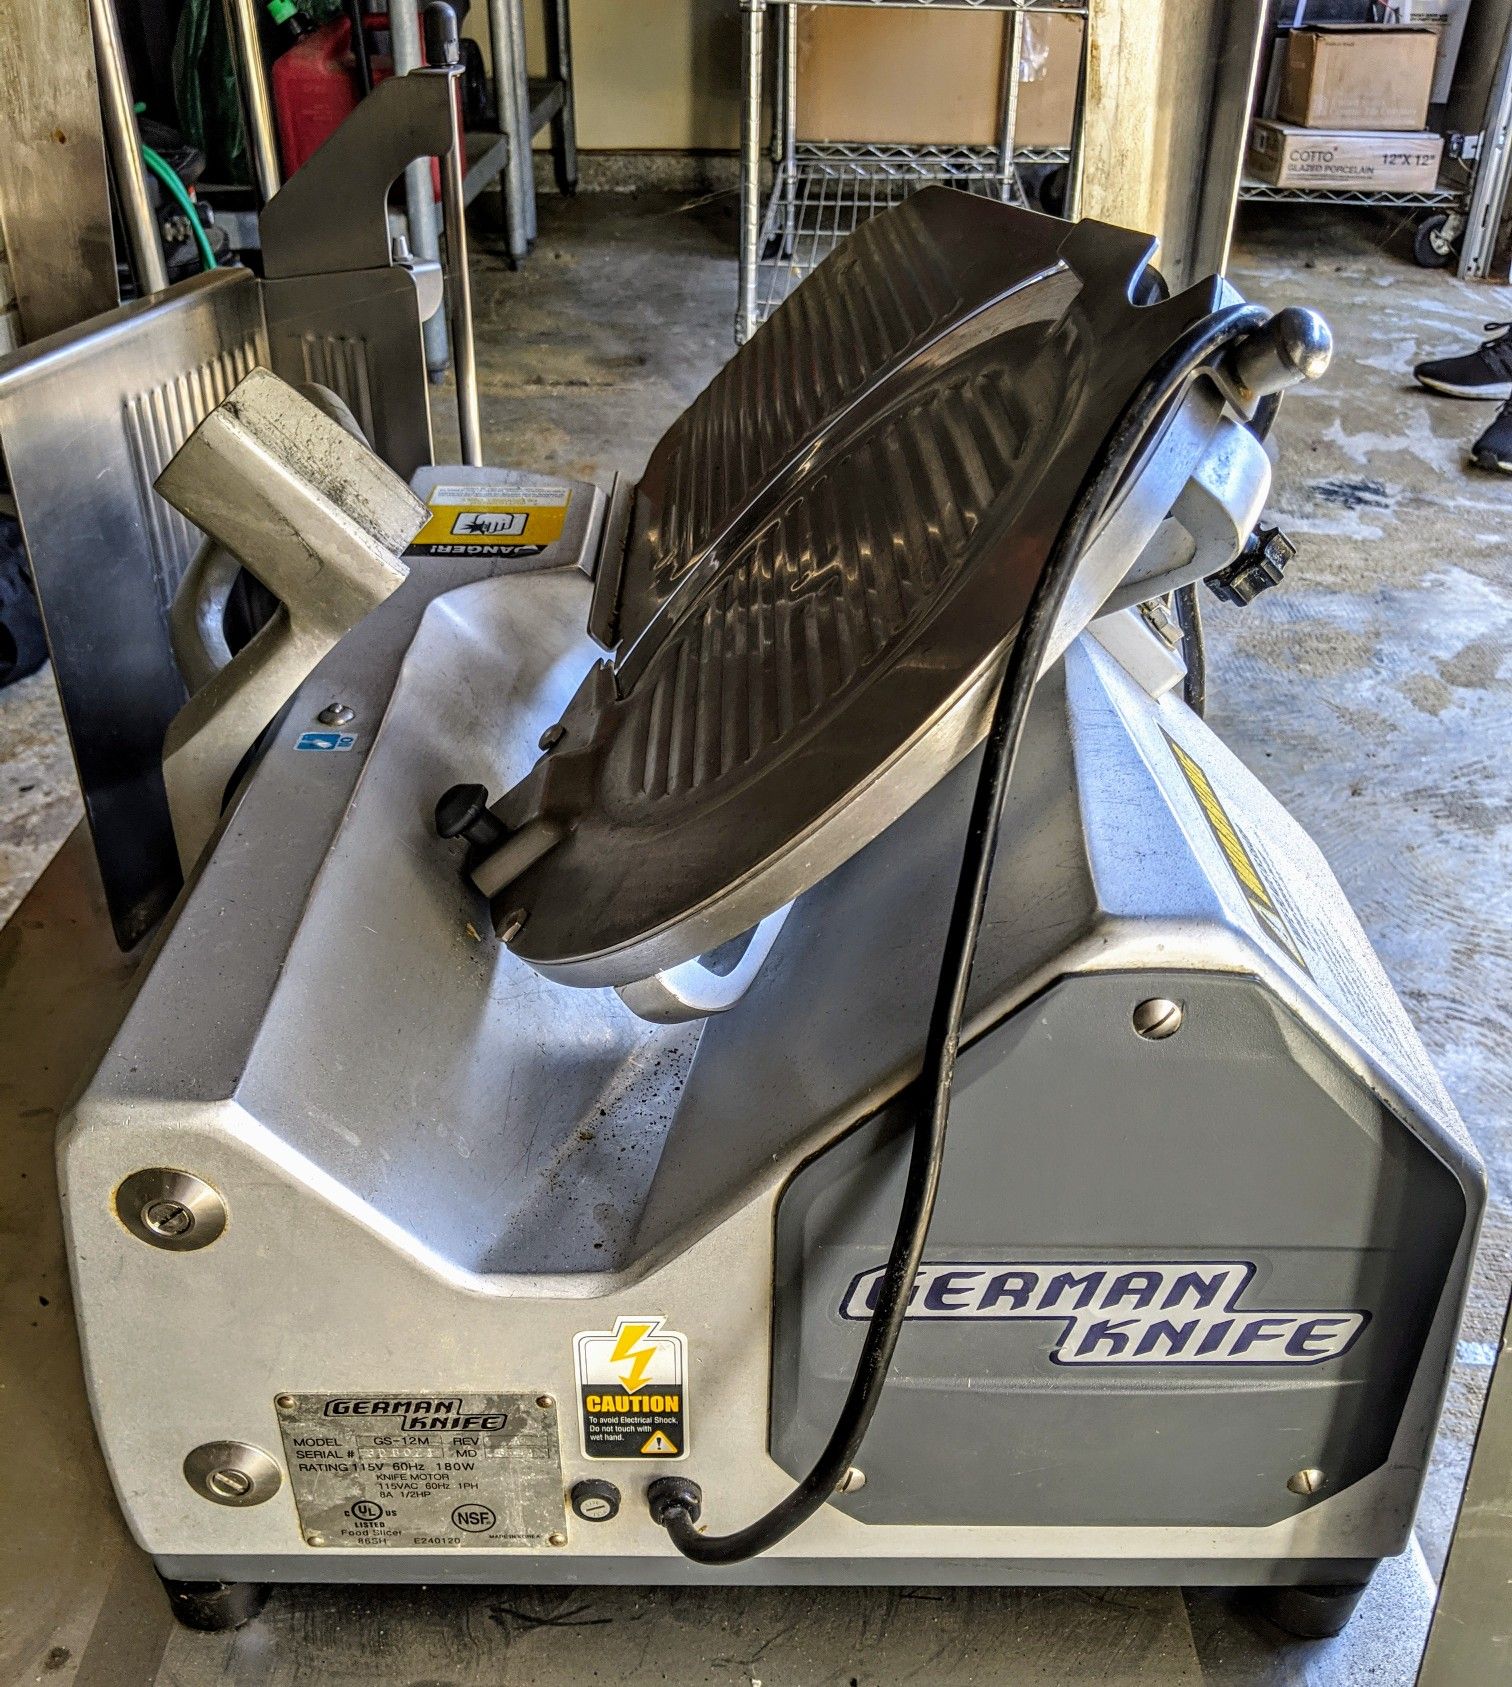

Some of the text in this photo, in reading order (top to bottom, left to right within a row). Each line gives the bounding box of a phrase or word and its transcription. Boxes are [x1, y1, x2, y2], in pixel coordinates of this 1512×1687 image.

[1289, 151, 1334, 162] COTTO
[1415, 155, 1435, 166] 12"
[1324, 165, 1375, 174] PORCELAIN
[1077, 1317, 1351, 1357] KNIFE
[332, 1401, 454, 1414] GERMAN
[586, 1395, 679, 1413] CAUTION
[409, 1416, 501, 1429] KNIFE
[589, 1416, 679, 1425] To avoid Electrical Shock,
[293, 1436, 479, 1447] MODEL GS-12M REV
[296, 1450, 344, 1459] SERIAL
[347, 1450, 355, 1458] #
[455, 1449, 477, 1458] MD
[298, 1462, 475, 1472] RATING 115V 60Hz 180W
[376, 1473, 450, 1481] KNIFE MOTOR
[378, 1482, 479, 1490] 115VAC 60Hz 1PH
[358, 1504, 376, 1517] UL
[457, 1511, 489, 1525] NSF
[341, 1529, 402, 1537] Food Slicer
[413, 1537, 461, 1545] E240120
